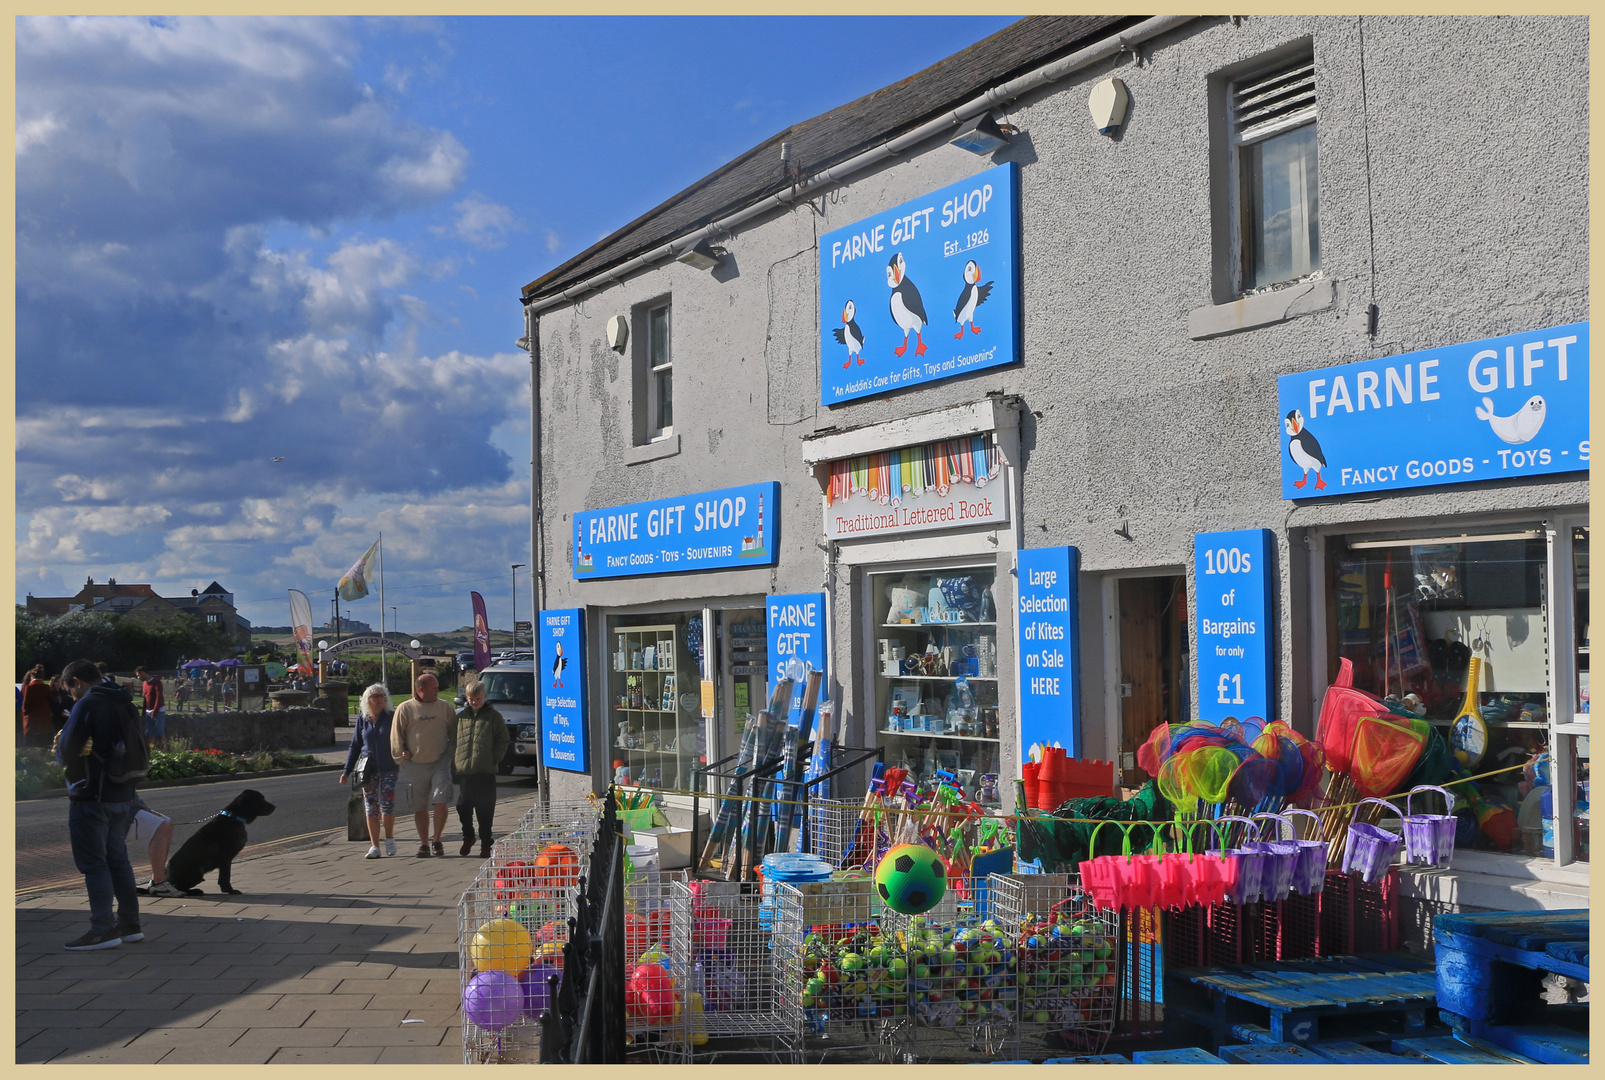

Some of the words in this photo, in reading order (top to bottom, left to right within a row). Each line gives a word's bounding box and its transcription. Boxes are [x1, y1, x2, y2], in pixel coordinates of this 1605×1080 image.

[831, 224, 885, 268] FARNE
[891, 207, 934, 246] GIFT
[941, 184, 993, 227] SHOP
[943, 240, 963, 256] Est.
[966, 229, 990, 249] 1926
[844, 378, 872, 395] Aladdin's
[873, 376, 889, 389] Cave
[889, 372, 901, 384] for
[901, 367, 923, 381] Gifts,
[924, 363, 941, 377] Toys
[941, 357, 956, 371] and
[1309, 359, 1441, 419] FARNE
[1468, 335, 1578, 394] GIFT
[1341, 465, 1399, 487] FANCY
[1405, 456, 1475, 480] GOODS
[1497, 448, 1553, 470] TOYS
[589, 512, 639, 545] FARNE
[647, 505, 686, 538] GIFT
[694, 496, 747, 533] SHOP
[835, 510, 900, 534] Traditional
[902, 502, 956, 527] Lettered
[958, 498, 994, 520] Rock
[606, 555, 628, 568] FANCY
[629, 552, 654, 566] GOODS
[660, 549, 680, 563] TOYS
[686, 545, 733, 561] SOUVENIRS
[1204, 547, 1252, 575] 100s
[1029, 568, 1058, 589] Large
[1020, 593, 1068, 614] Selection
[1221, 588, 1236, 607] of
[546, 616, 561, 626] FARNE
[560, 615, 571, 626] GIFT
[770, 602, 816, 629] FARNE
[552, 627, 565, 637] SHOP
[1024, 621, 1036, 641] of
[1038, 621, 1064, 640] Kites
[1202, 617, 1256, 639] Bargains
[331, 638, 379, 655] SEAFIELD
[381, 640, 408, 653] PARK
[776, 632, 811, 656] GIFT
[1215, 644, 1226, 657] for
[1227, 645, 1245, 659] only
[1026, 653, 1040, 668] on
[1041, 648, 1064, 668] Sale
[1031, 677, 1060, 696] HERE
[1216, 672, 1245, 705] £1
[545, 697, 557, 709] Large
[557, 697, 577, 709] Selection
[553, 714, 559, 725] of
[558, 714, 570, 727] Toys,
[549, 731, 561, 744] Fancy
[561, 732, 575, 744] Goods
[550, 748, 555, 759] &
[554, 748, 576, 761] Souvenirs
